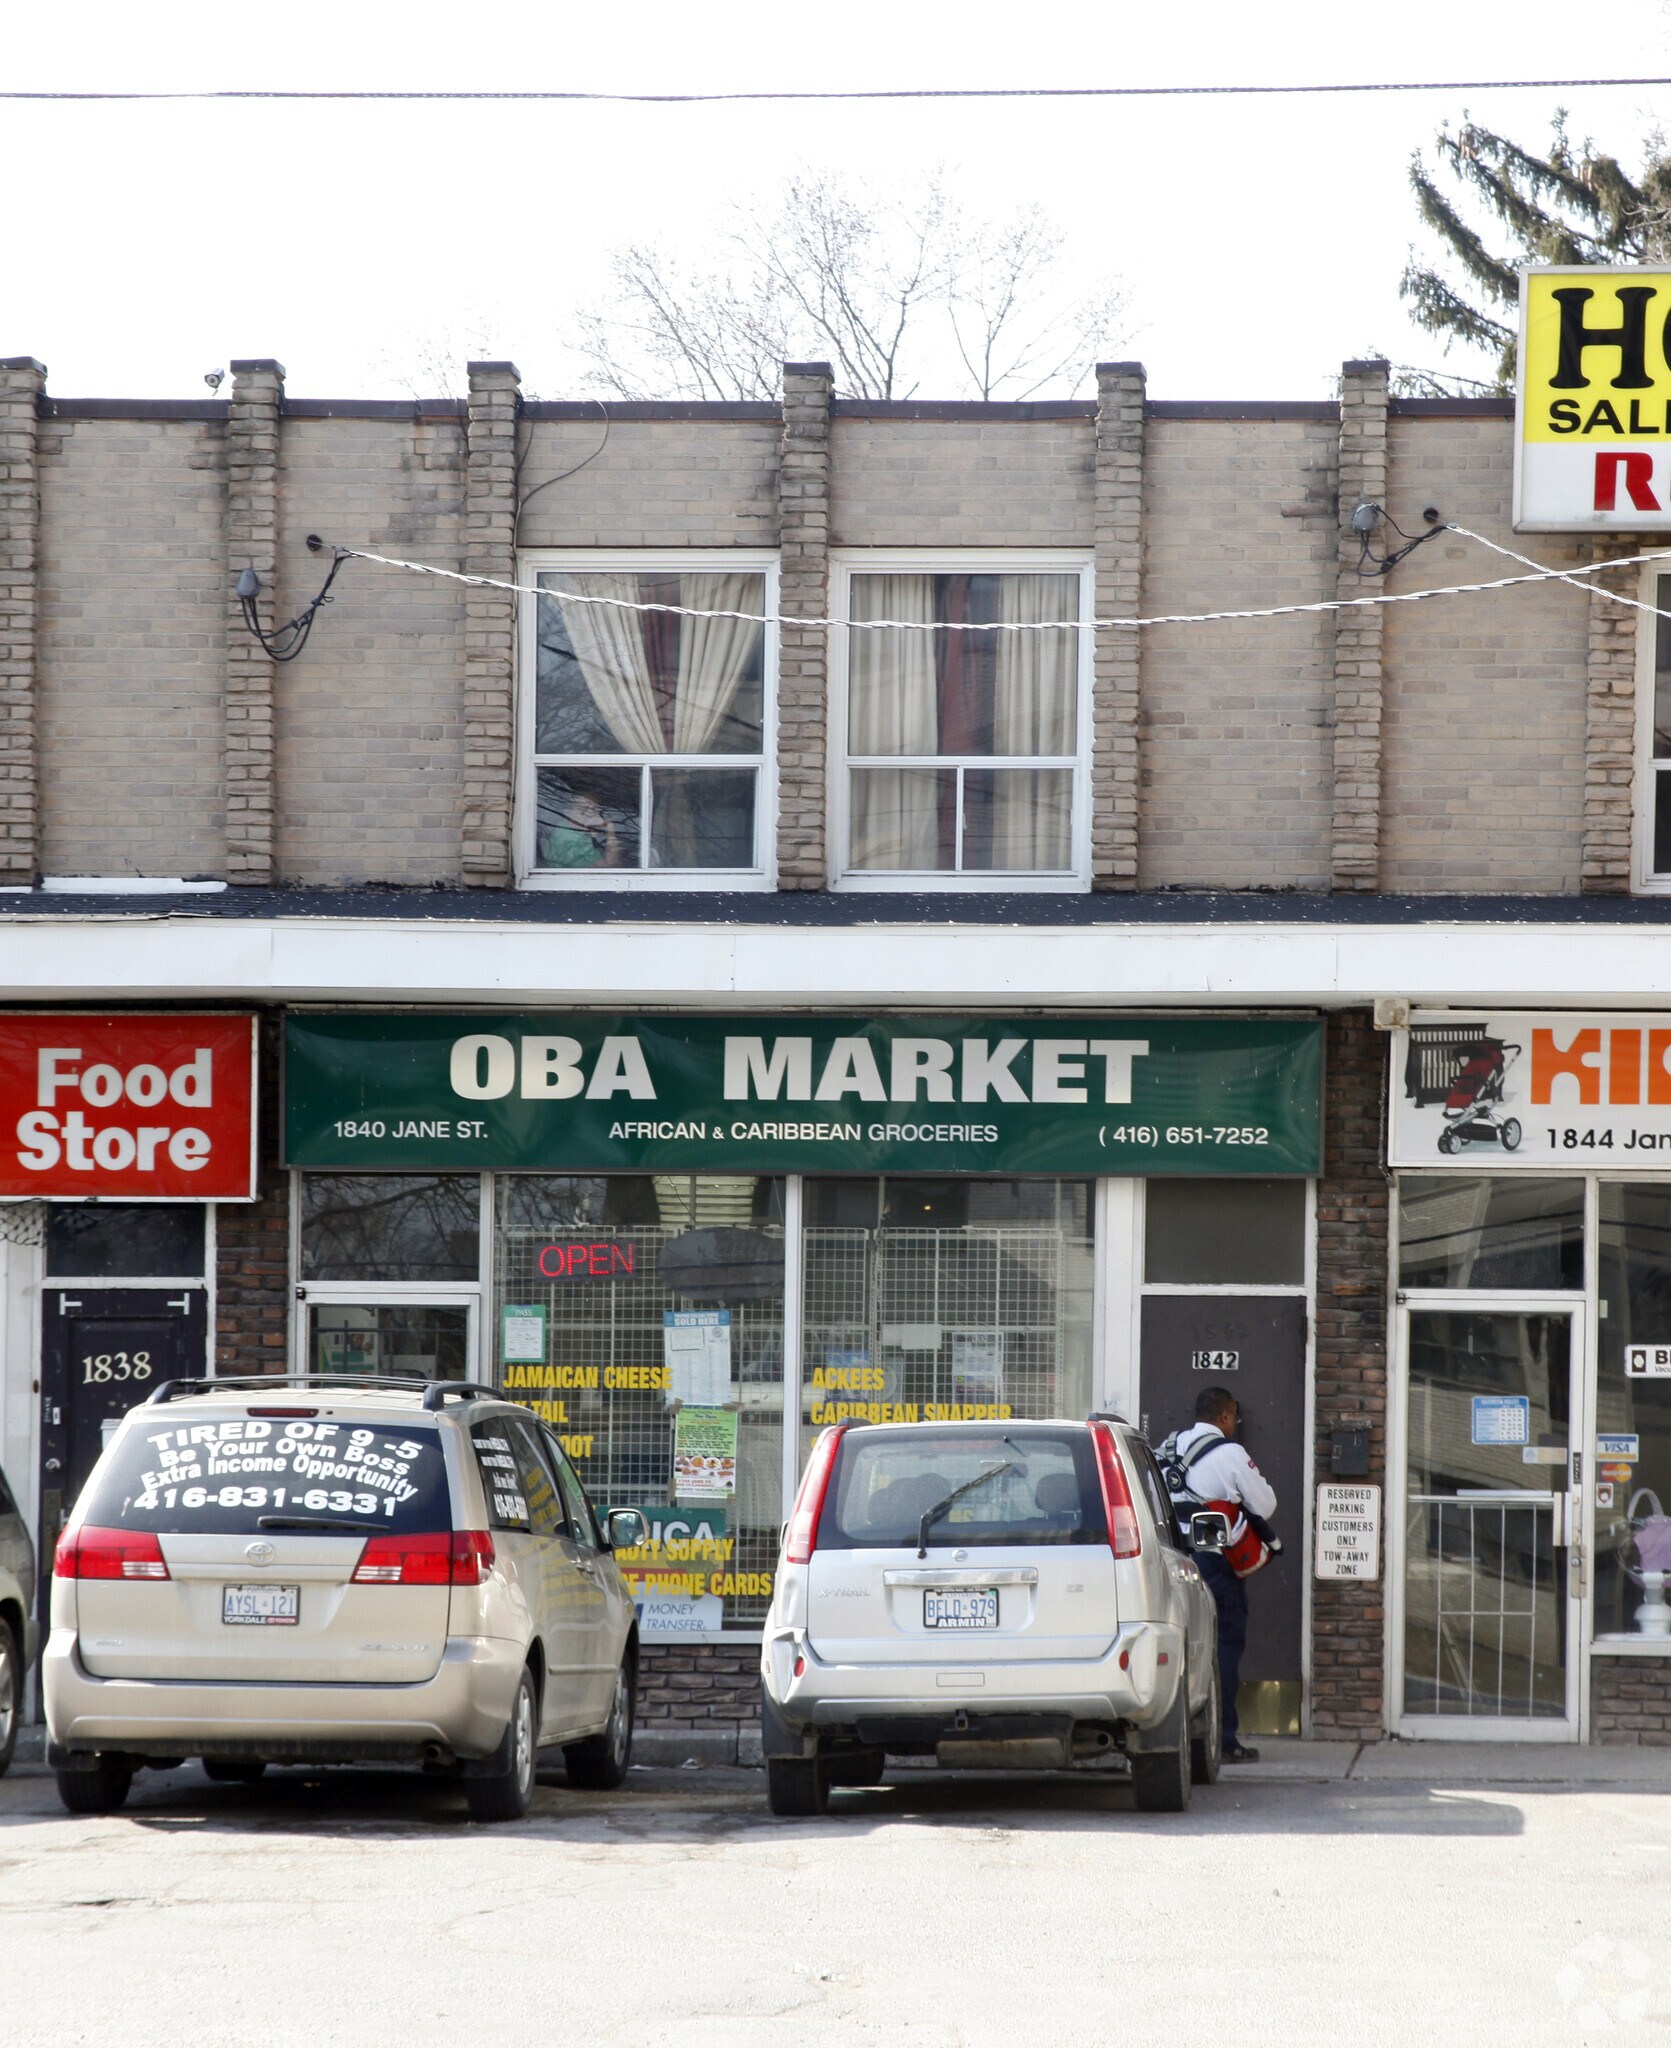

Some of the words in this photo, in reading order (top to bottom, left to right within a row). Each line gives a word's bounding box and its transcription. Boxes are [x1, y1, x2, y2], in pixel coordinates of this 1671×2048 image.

[1549, 287, 1671, 389] H
[1548, 399, 1671, 434] SAL
[1594, 452, 1671, 511] R
[37, 1048, 212, 1108] Food
[450, 1034, 658, 1100] OBA
[724, 1036, 1150, 1104] MARKET
[16, 1110, 212, 1171] Store
[333, 1120, 386, 1138] 1840
[391, 1120, 451, 1139] JANE
[456, 1120, 489, 1139] ST.
[608, 1121, 706, 1140] AFRICAN
[712, 1126, 725, 1140] &
[730, 1122, 861, 1142] CARIBBEAN
[867, 1123, 999, 1143] GROCERIES
[1166, 1127, 1269, 1145] 651-7252
[1547, 1128, 1614, 1149] 1844
[538, 1243, 634, 1277] OPEN
[674, 1317, 698, 1327] SOLD
[82, 1351, 152, 1384] 1838
[1193, 1351, 1238, 1369] 1842
[1655, 1350, 1671, 1364] B
[503, 1366, 598, 1389] JAMAICAN
[603, 1367, 673, 1389] CHEESE
[812, 1368, 885, 1390] ACKEES
[530, 1400, 569, 1423] TAIL
[811, 1402, 918, 1424] CARIBBEAN
[924, 1403, 1012, 1421] SNAPPER
[147, 1422, 271, 1450] TIRED
[285, 1422, 339, 1441] OF
[349, 1429, 374, 1447] 9
[159, 1449, 196, 1468] Be
[205, 1439, 268, 1457] Your
[275, 1438, 336, 1458] Own
[344, 1445, 410, 1475] Boss
[1604, 1442, 1630, 1453] VISA
[140, 1463, 202, 1490] Extra
[208, 1456, 287, 1475] Income
[293, 1454, 419, 1502] Opportunity
[134, 1486, 397, 1516] 416-831-6331
[1328, 1488, 1371, 1499] RESERVED
[1329, 1503, 1365, 1514] PARKING
[1322, 1521, 1374, 1532] CUSTOMERS
[666, 1538, 734, 1561] SUPPLY
[1337, 1535, 1357, 1546] ONLY
[1324, 1551, 1369, 1562] TOW-AWAY
[1336, 1564, 1357, 1575] ZONE
[645, 1573, 706, 1595] PHONE
[710, 1573, 772, 1596] CARDS
[648, 1603, 696, 1614] MONEY
[970, 1598, 996, 1617] 979
[646, 1619, 704, 1630] TRANSFER
[938, 1617, 985, 1627] ARMIN
